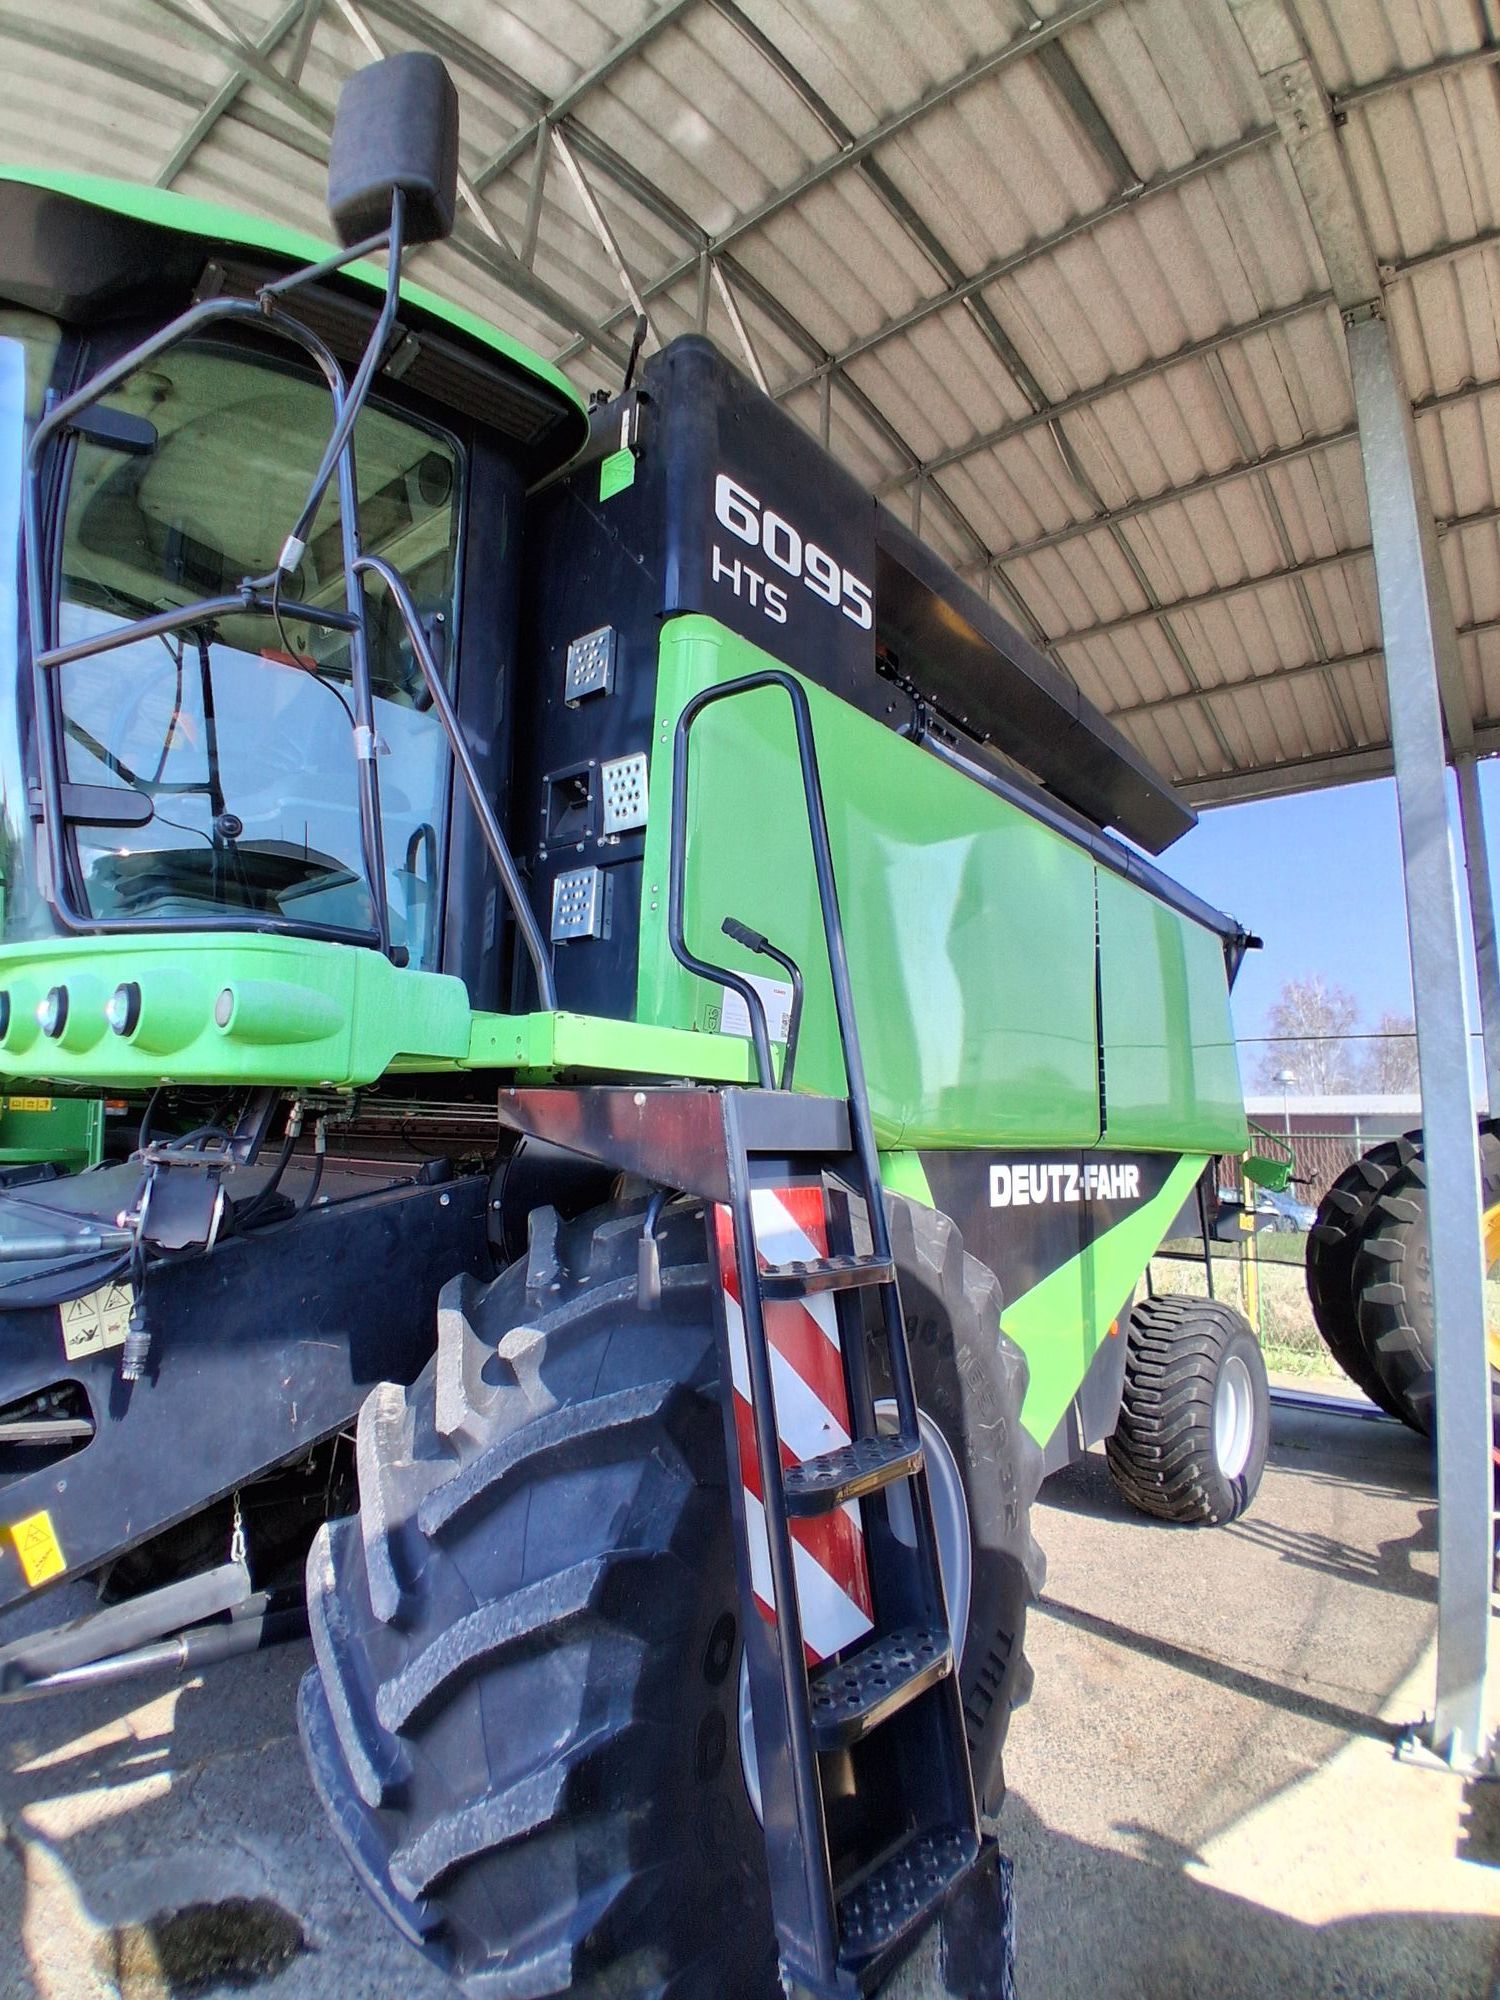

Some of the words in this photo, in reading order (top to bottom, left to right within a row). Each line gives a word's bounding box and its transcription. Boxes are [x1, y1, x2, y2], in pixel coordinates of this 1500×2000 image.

[712, 545, 787, 624] HTS
[715, 474, 872, 630] 6095
[989, 1163, 1140, 1208] DEUTZ-FAHR
